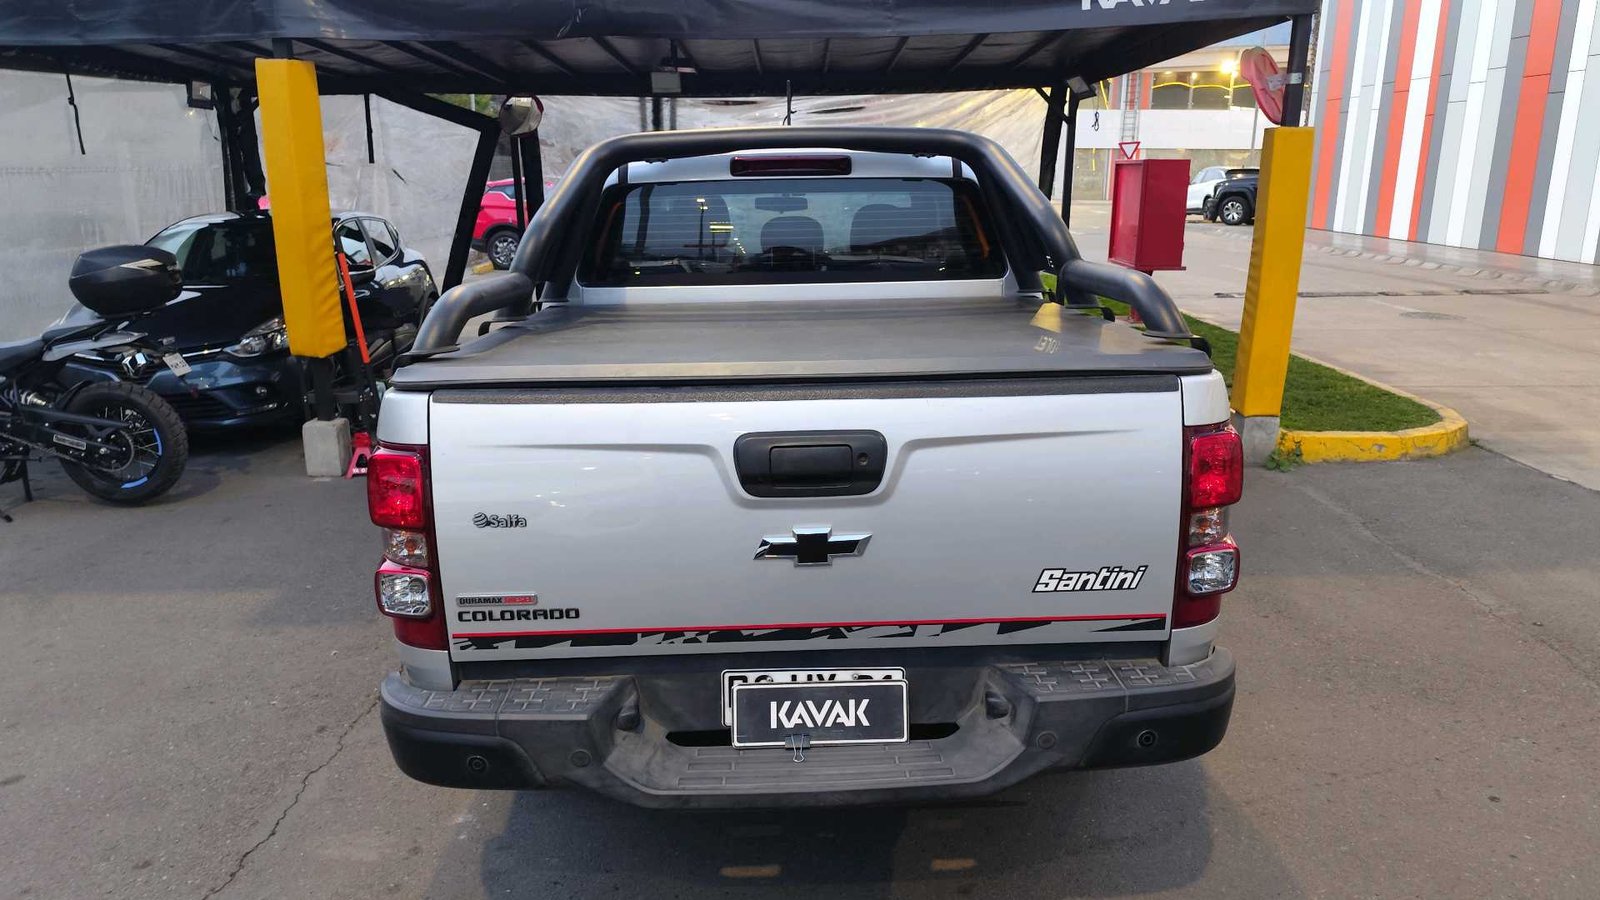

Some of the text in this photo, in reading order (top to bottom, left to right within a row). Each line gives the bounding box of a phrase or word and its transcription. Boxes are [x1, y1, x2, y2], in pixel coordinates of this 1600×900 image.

[489, 514, 527, 528] Salfa
[1032, 565, 1149, 593] Santini
[459, 597, 503, 605] DURAMAX
[457, 608, 580, 622] COLORADO
[770, 699, 870, 729] KAVAK
